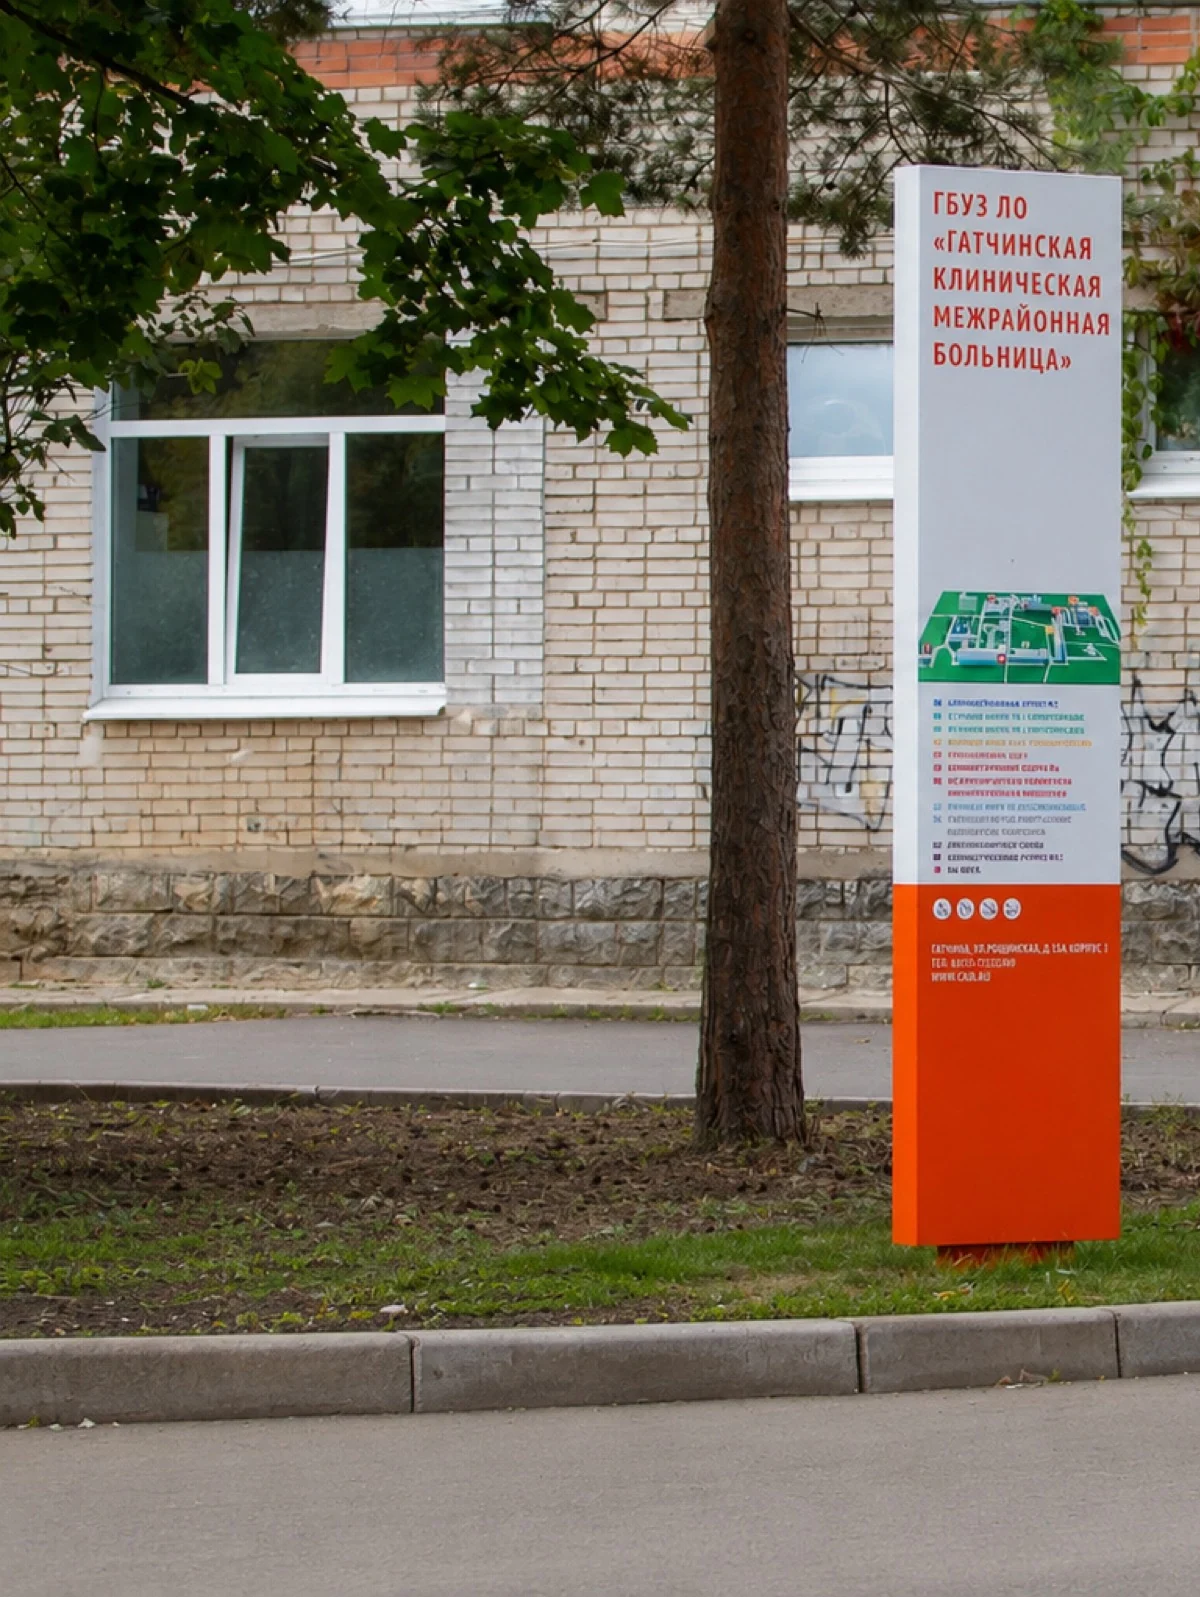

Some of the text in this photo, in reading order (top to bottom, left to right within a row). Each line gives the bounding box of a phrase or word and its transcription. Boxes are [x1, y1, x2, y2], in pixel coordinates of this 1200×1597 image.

[933, 191, 1027, 220] ГБУЗ ЛО
[933, 230, 1092, 260] «ГАТЧИНСКАЯ
[933, 267, 1101, 298] КЛИНИЧЕСКАЯ
[933, 303, 1111, 336] МЕЖРАЙОННАЯ
[933, 342, 1072, 374] БОЛЬНИЦА»
